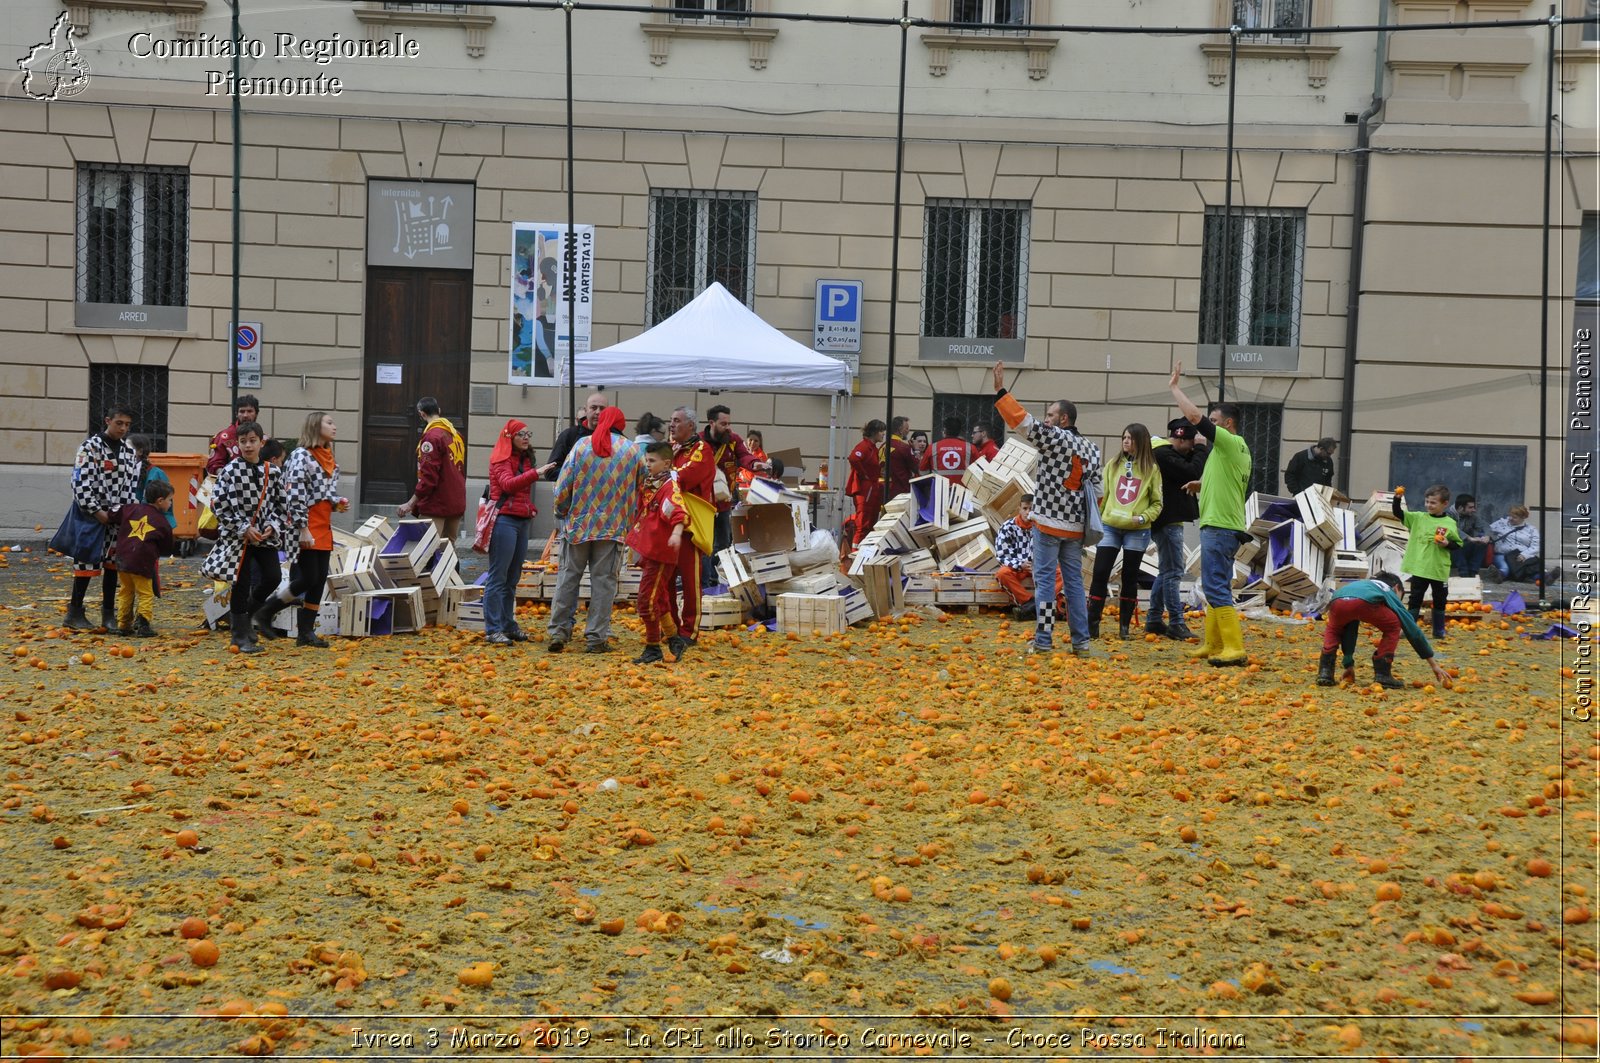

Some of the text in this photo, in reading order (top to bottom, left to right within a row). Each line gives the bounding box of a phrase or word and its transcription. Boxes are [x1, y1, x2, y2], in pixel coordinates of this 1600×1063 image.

[381, 188, 421, 198] internilab
[582, 232, 591, 248] 1.0
[562, 232, 578, 303] INTERNI
[580, 248, 591, 304] D'ARTISTA
[828, 287, 850, 318] P
[119, 311, 148, 322] ARREDI
[948, 344, 995, 355] PRODUZIONE
[1230, 352, 1264, 362] VENDITA
